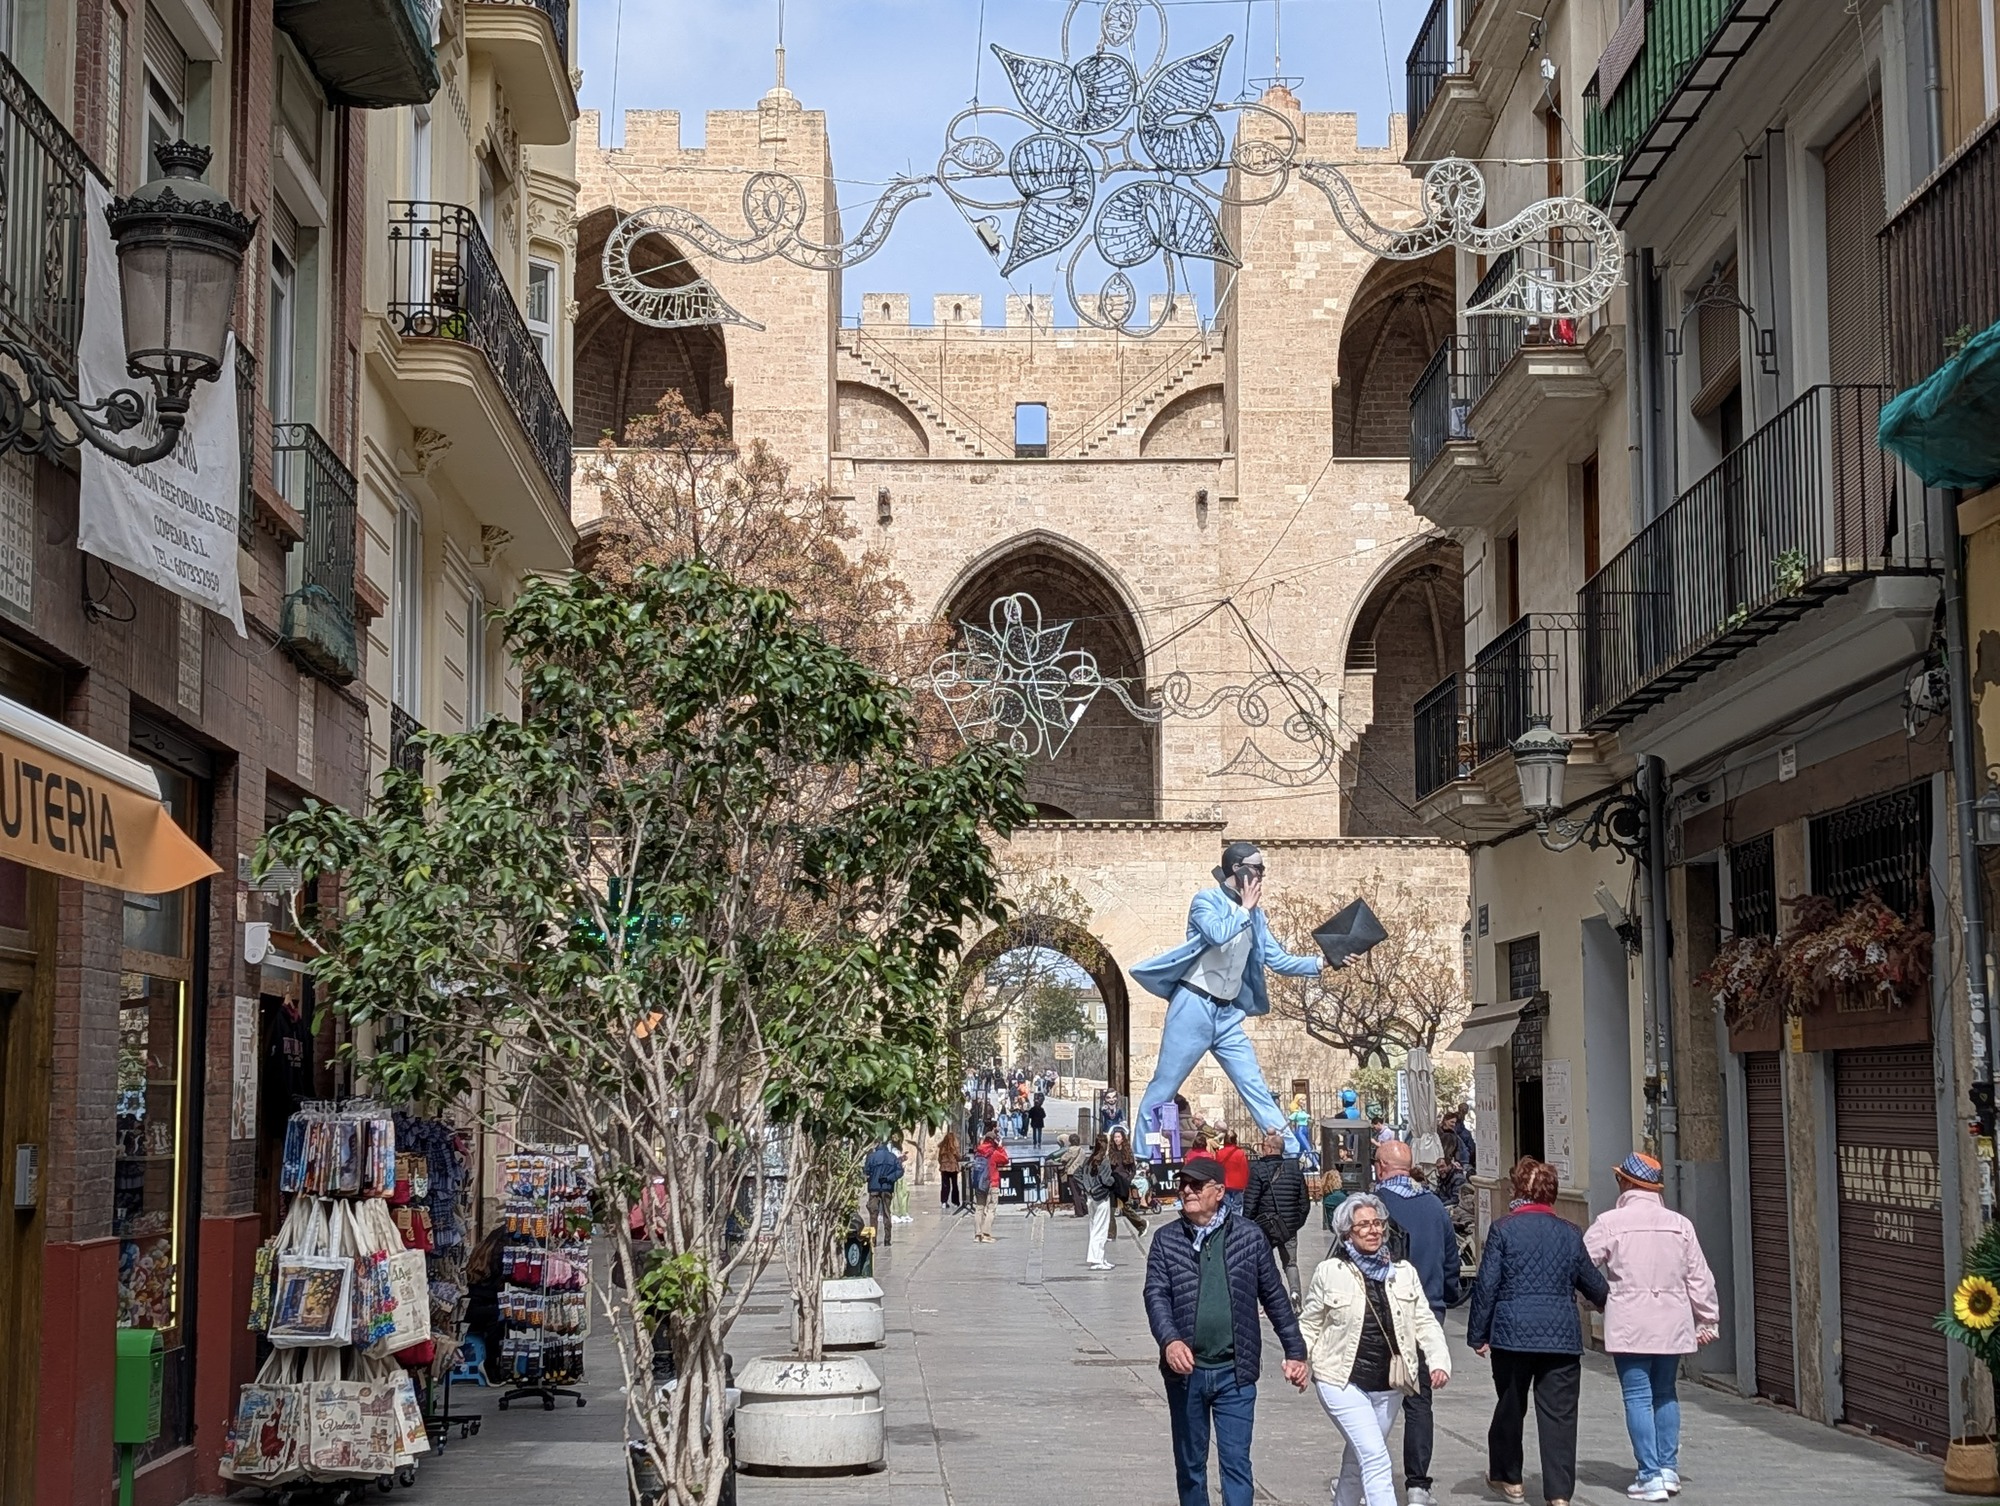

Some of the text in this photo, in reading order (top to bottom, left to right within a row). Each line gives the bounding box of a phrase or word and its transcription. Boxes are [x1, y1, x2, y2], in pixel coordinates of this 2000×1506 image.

[158, 476, 216, 523] REFORMAS
[154, 514, 192, 552] COPEMA
[1874, 1211, 1914, 1244] SPAIN
